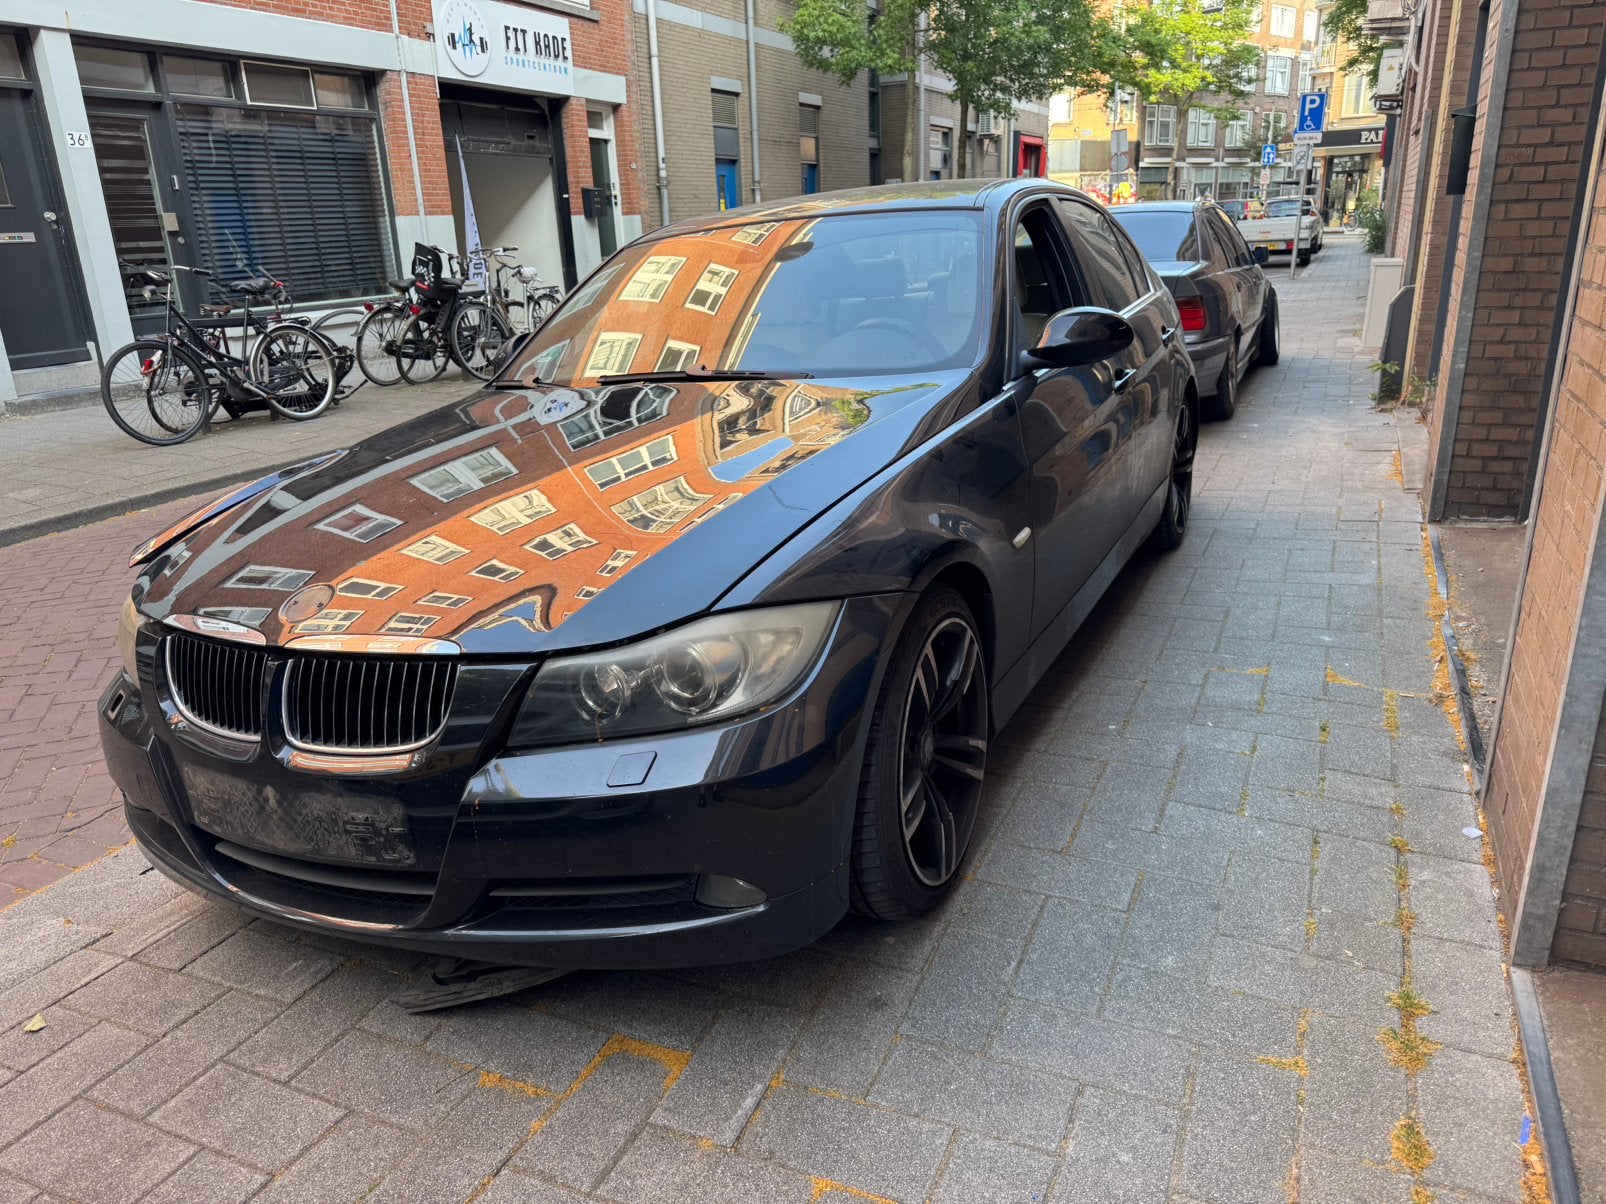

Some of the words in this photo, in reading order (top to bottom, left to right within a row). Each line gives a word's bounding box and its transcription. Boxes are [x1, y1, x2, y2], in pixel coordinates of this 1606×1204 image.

[504, 25, 528, 53] FIT
[533, 31, 569, 61] KADE
[504, 56, 568, 75] SPORTCENTRUM
[1304, 95, 1320, 116] P
